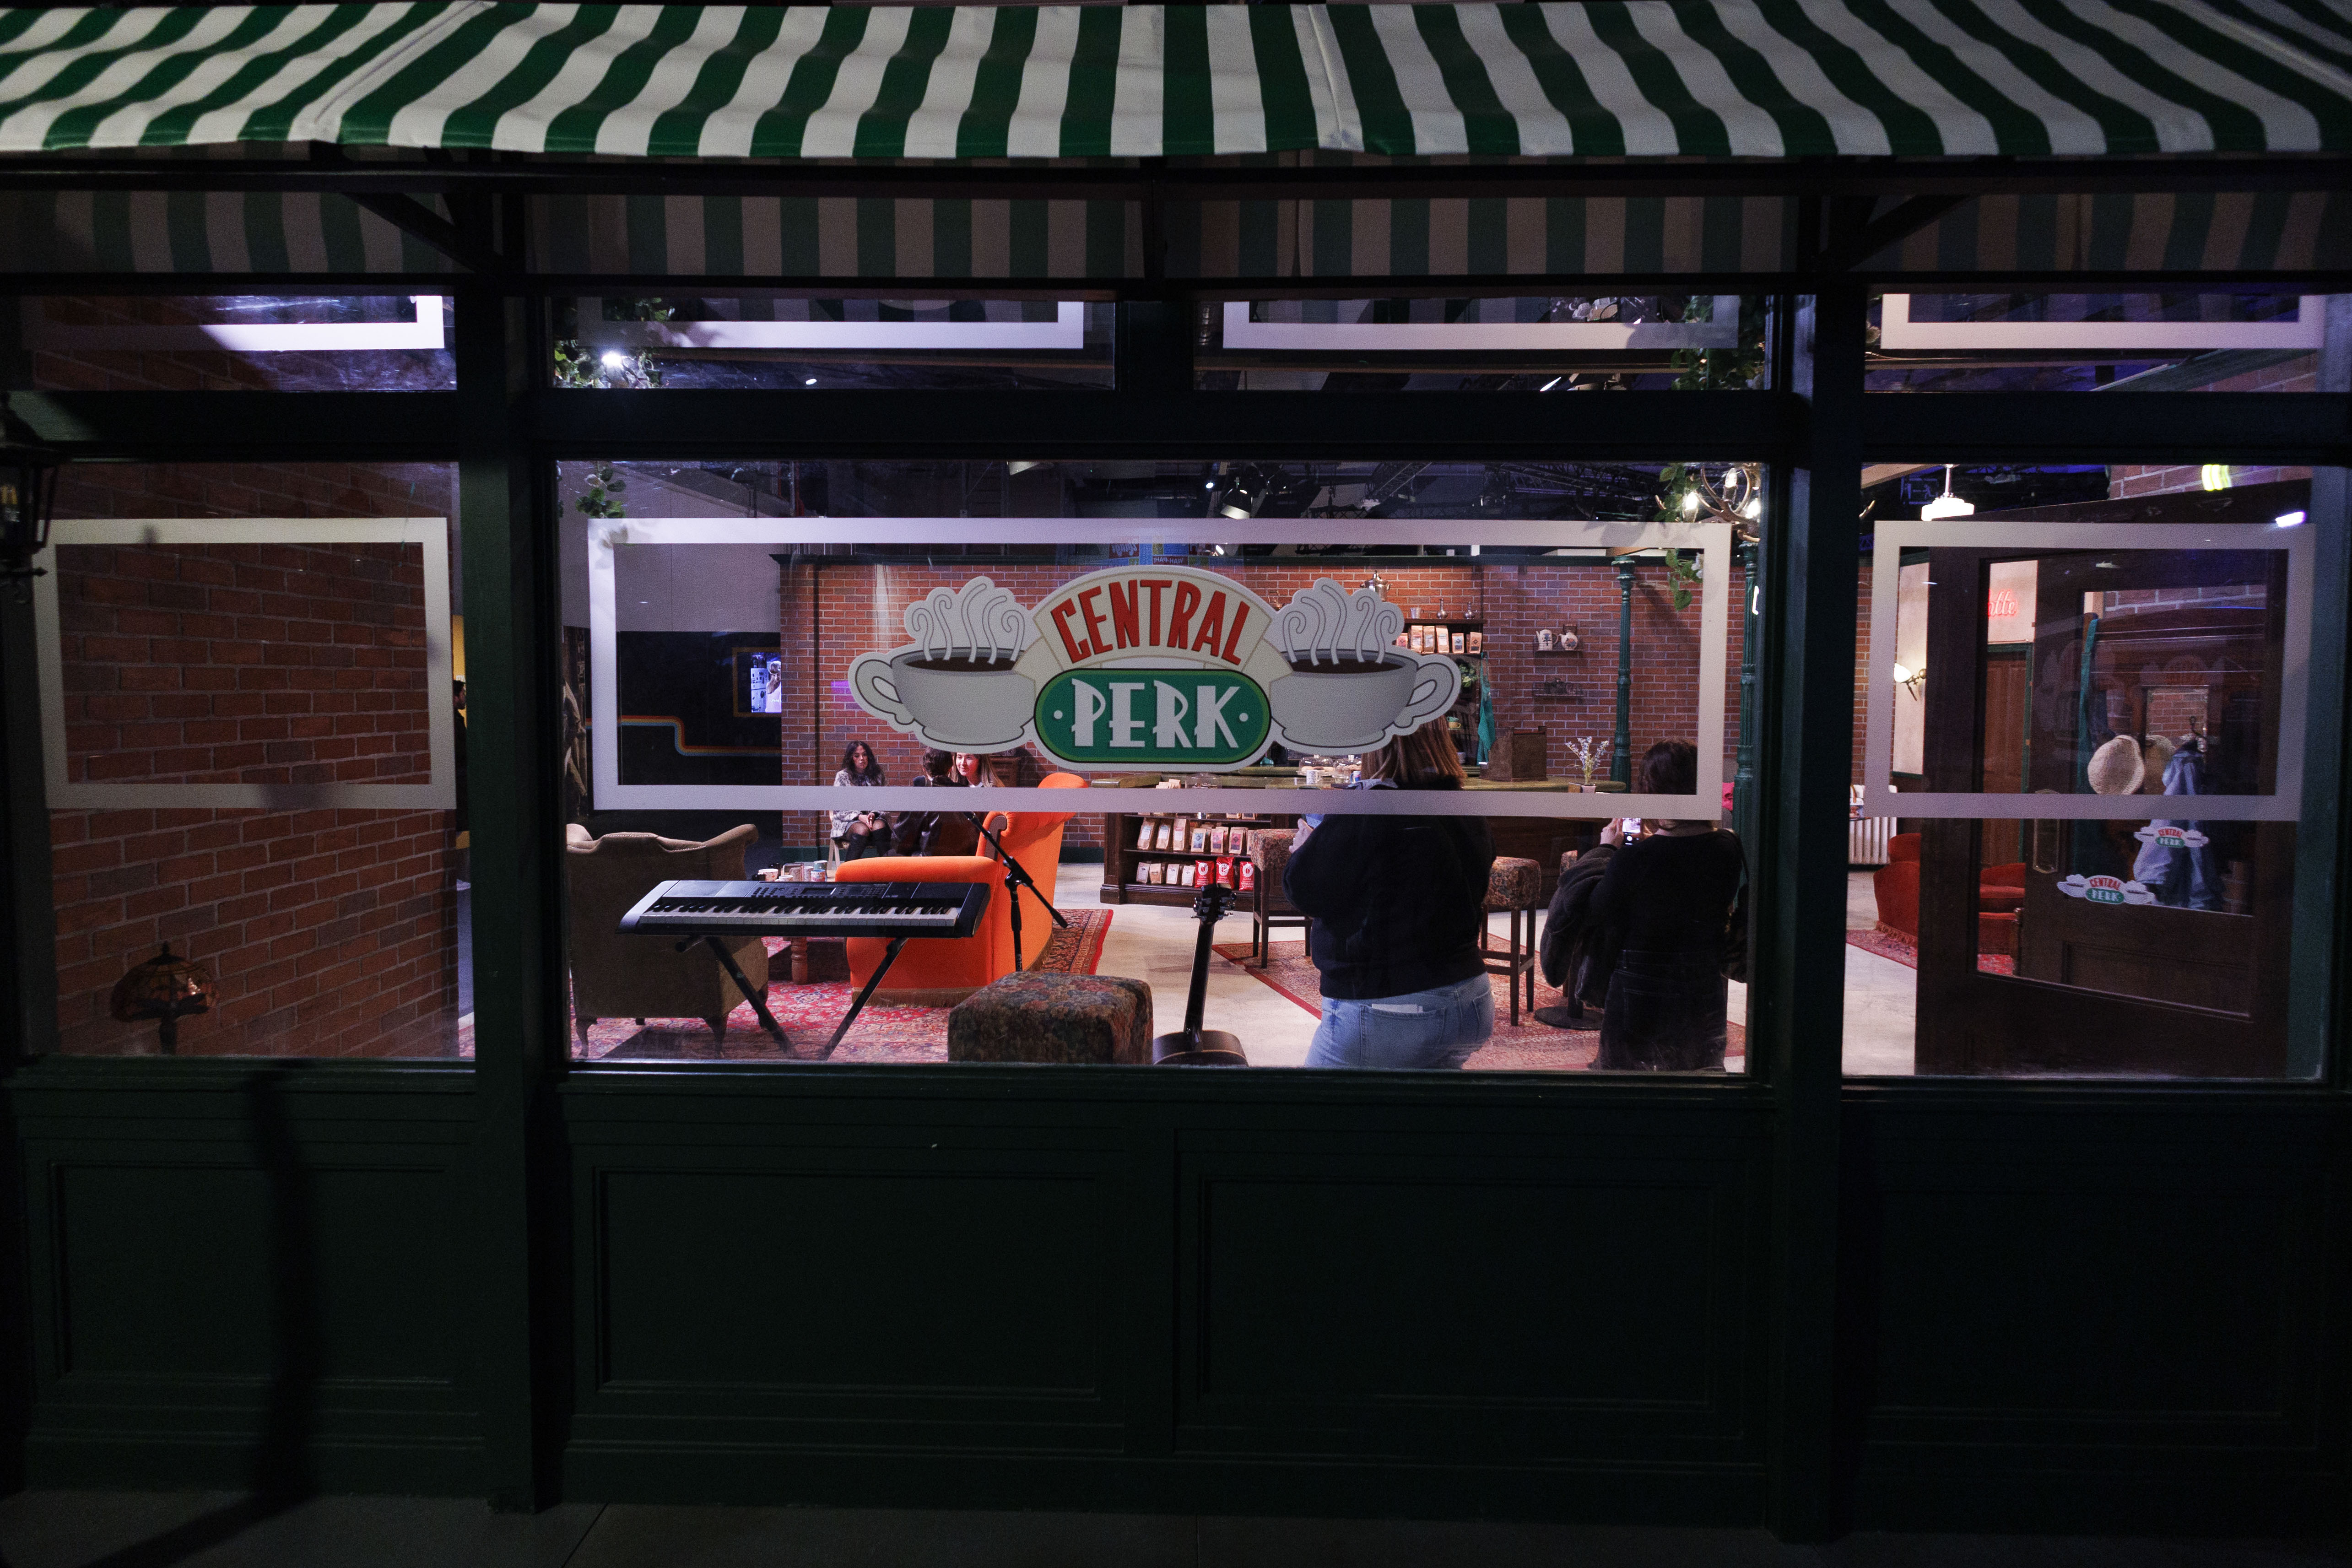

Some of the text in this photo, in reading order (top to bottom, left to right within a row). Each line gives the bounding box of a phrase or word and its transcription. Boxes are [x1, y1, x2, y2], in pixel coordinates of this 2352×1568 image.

[1988, 591, 2016, 616] atte
[1050, 579, 1251, 665] CENTRAL
[1071, 679, 1240, 749] PERK
[2158, 829, 2183, 838] CENTRAL
[2090, 878, 2121, 890] CENTRAL
[2092, 891, 2118, 901] PERK
